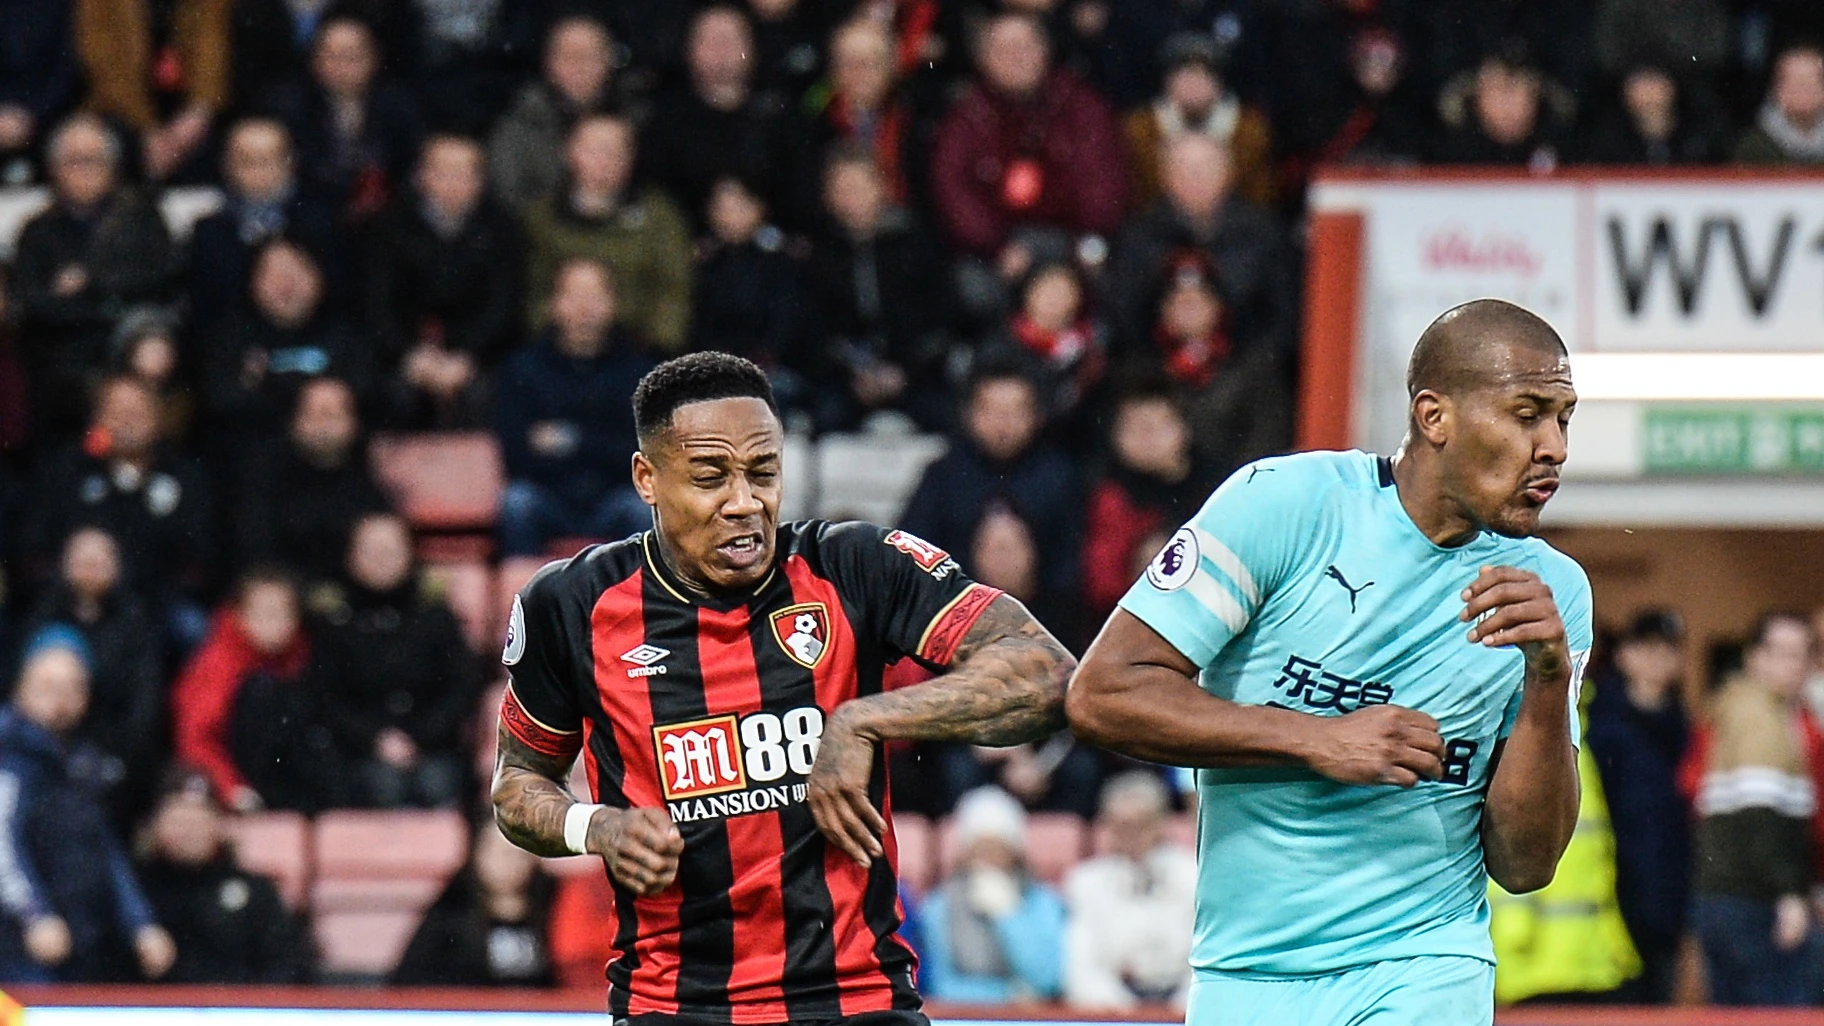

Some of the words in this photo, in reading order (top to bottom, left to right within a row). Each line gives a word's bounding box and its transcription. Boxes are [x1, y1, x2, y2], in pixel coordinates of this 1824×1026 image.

[627, 664, 667, 678] umbro
[654, 706, 823, 794] M88
[667, 774, 789, 824] MANSION
